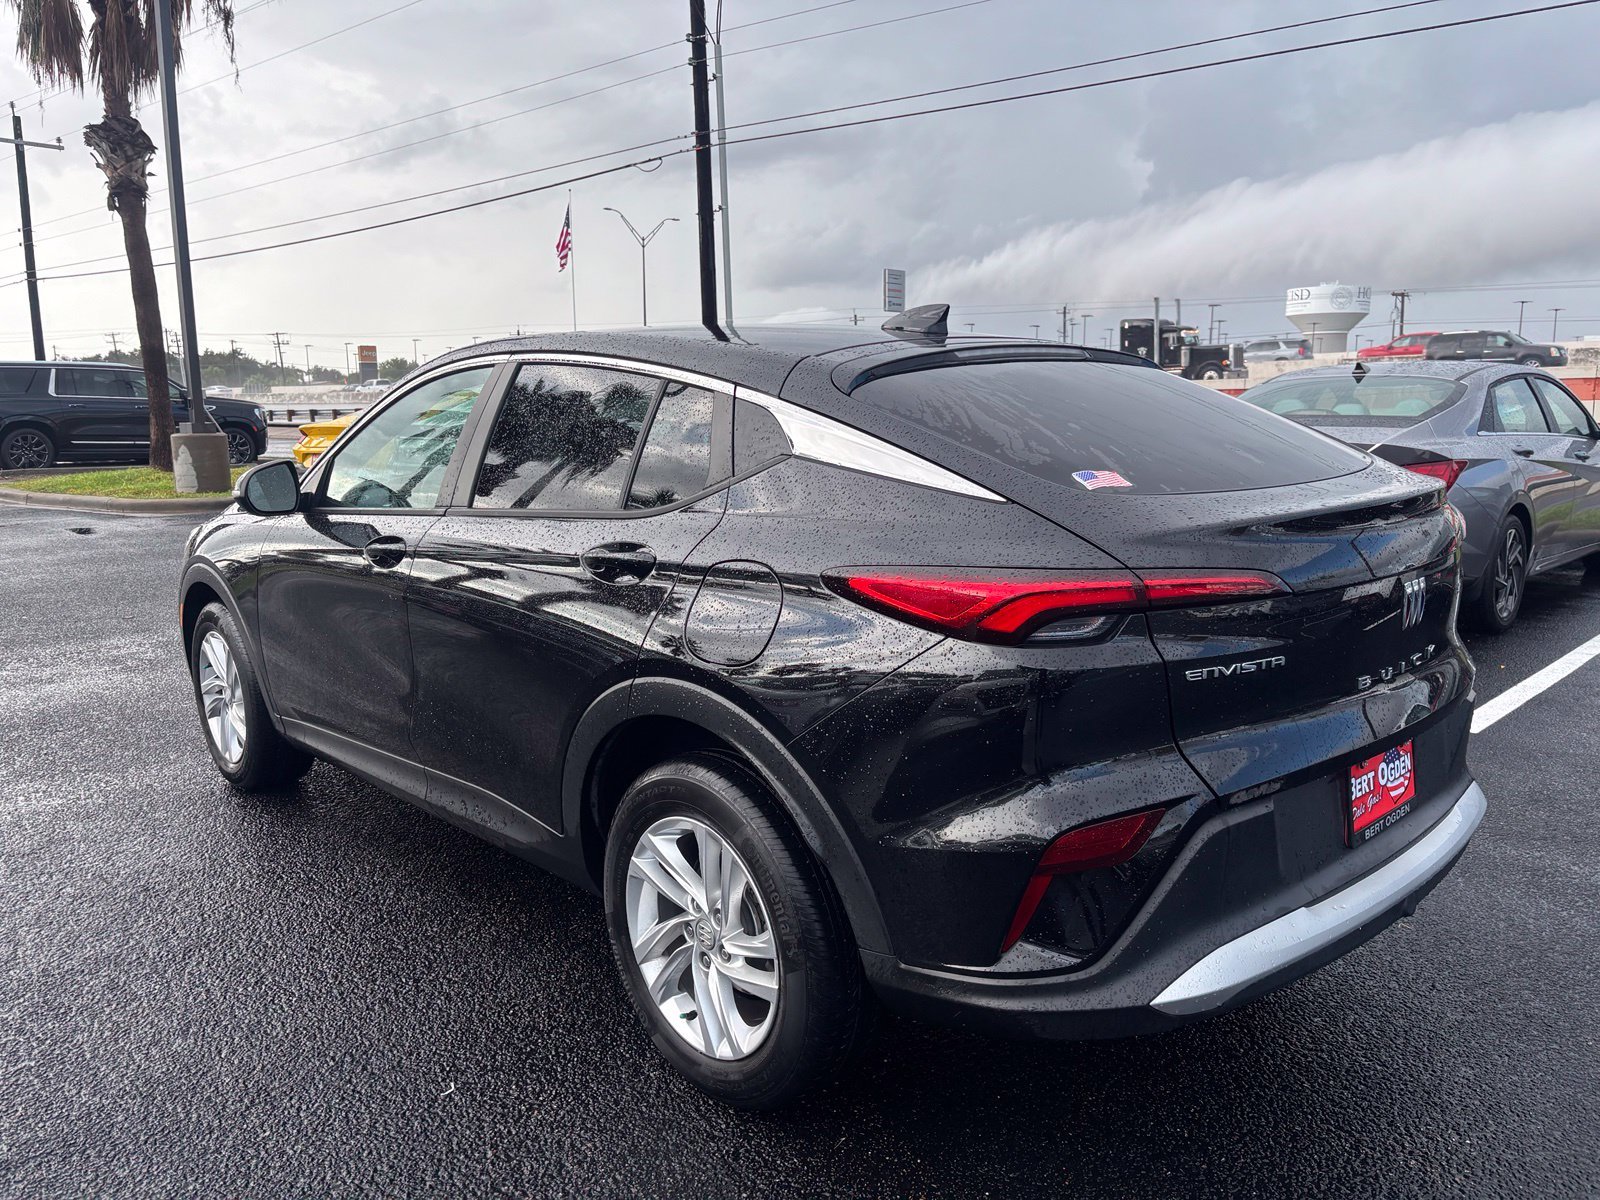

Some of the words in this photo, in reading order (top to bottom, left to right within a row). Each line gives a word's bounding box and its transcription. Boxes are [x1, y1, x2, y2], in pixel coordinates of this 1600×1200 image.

[361, 350, 377, 358] Jeep
[1185, 655, 1287, 682] ENVISTA
[1358, 644, 1436, 690] BUICK
[1351, 771, 1375, 801] BERT
[1378, 752, 1412, 786] OGDEN
[1364, 819, 1385, 840] BERT
[1385, 803, 1411, 827] OGDEN
